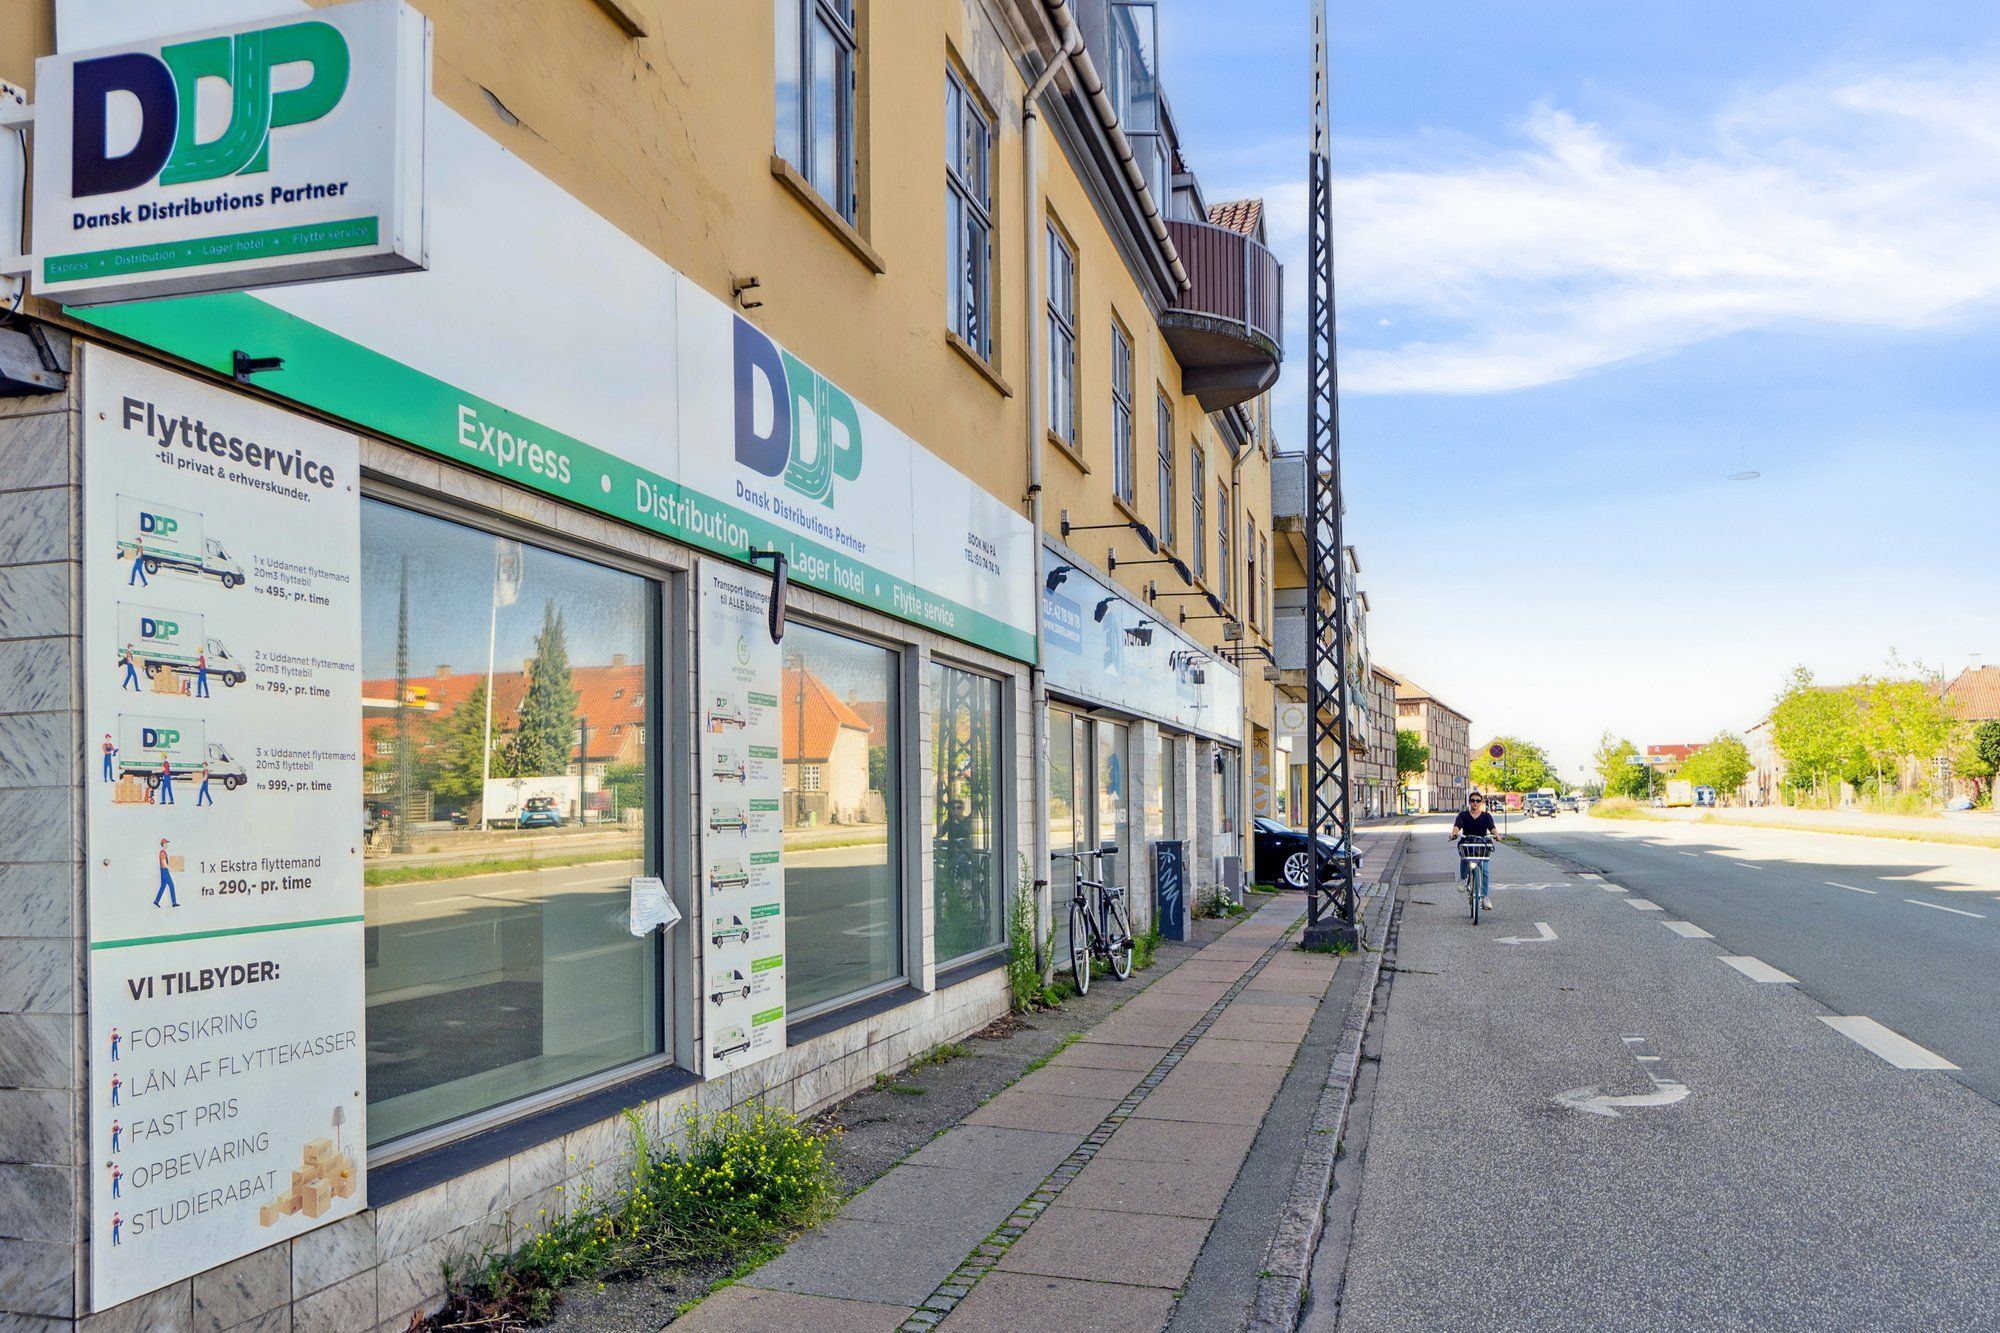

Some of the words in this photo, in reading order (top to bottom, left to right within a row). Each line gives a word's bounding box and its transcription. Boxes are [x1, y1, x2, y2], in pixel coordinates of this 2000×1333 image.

[72, 21, 350, 198] DDP
[73, 205, 133, 230] Dansk
[138, 190, 264, 222] Distributions
[271, 181, 348, 207] Partner
[50, 260, 89, 274] Express
[115, 249, 175, 266] Distribution
[203, 241, 234, 256] Lager
[236, 237, 264, 252] hotel
[292, 228, 326, 245] Flytte
[328, 225, 368, 239] service
[733, 313, 862, 510] DDP
[123, 396, 334, 489] Flytteservice
[156, 451, 174, 465] -til
[178, 458, 214, 476] privat
[217, 467, 225, 479] &
[229, 471, 310, 503] erhverskunder.
[140, 511, 178, 536] DDP
[458, 403, 572, 484] Express
[636, 478, 748, 551] Distribution
[790, 543, 831, 583] Lager
[833, 558, 864, 595] hotel
[893, 584, 922, 617] Flytte
[924, 601, 954, 629] service
[736, 479, 770, 511] Dansk
[773, 497, 833, 540] Distributions
[835, 527, 866, 554] Partner
[968, 532, 981, 551] BOOK
[982, 540, 990, 554] NU
[253, 555, 258, 565] 1
[260, 558, 265, 566] x
[267, 558, 307, 574] Uddannet
[308, 566, 350, 583] flyttemand
[254, 567, 278, 581] 20m3
[280, 572, 311, 587] flyttebil
[254, 586, 264, 594] fra
[266, 585, 292, 600] 495,-
[294, 592, 307, 602] pr.
[309, 593, 330, 606] time
[713, 576, 743, 595] Transport
[720, 594, 728, 605] til
[728, 597, 745, 611] ALLE
[745, 601, 765, 616] behov.
[141, 617, 179, 640] DDP
[255, 650, 260, 660] 2
[262, 652, 267, 661] x
[269, 652, 309, 666] Uddannet
[311, 657, 355, 672] flyttemænd
[255, 663, 279, 674] 20m3
[281, 665, 312, 678] flyttebil
[255, 683, 265, 691] fra
[267, 681, 292, 696] 799,-
[294, 685, 307, 697] pr.
[309, 686, 331, 698] time
[142, 728, 180, 749] DDP
[256, 747, 261, 757] 3
[263, 749, 269, 758] x
[270, 748, 310, 759] Uddannet
[312, 750, 356, 761] flyttemænd
[256, 760, 280, 770] 20m3
[282, 760, 314, 772] flyttebil
[256, 782, 266, 790] fra
[268, 779, 294, 793] 999,-
[296, 781, 309, 792] pr.
[311, 781, 332, 792] time
[200, 861, 206, 874] 1
[209, 864, 217, 874] x
[220, 858, 258, 873] Ekstra
[261, 856, 321, 873] flyttemand
[201, 886, 215, 896] fra
[218, 879, 257, 898] 290,-
[260, 879, 279, 895] pr.
[282, 876, 312, 891] time
[127, 976, 153, 1001] VI
[161, 960, 280, 996] TILBYDER:
[131, 1010, 258, 1051] FORSIKRING
[131, 1069, 176, 1098] LÅN
[184, 1060, 211, 1086] AF
[218, 1030, 356, 1077] FLYTTEKASSER
[132, 1110, 187, 1143] FAST
[195, 1098, 238, 1127] PRIS
[131, 1131, 269, 1189] OPBEVARING
[131, 1170, 277, 1235] STUDIERABAT
